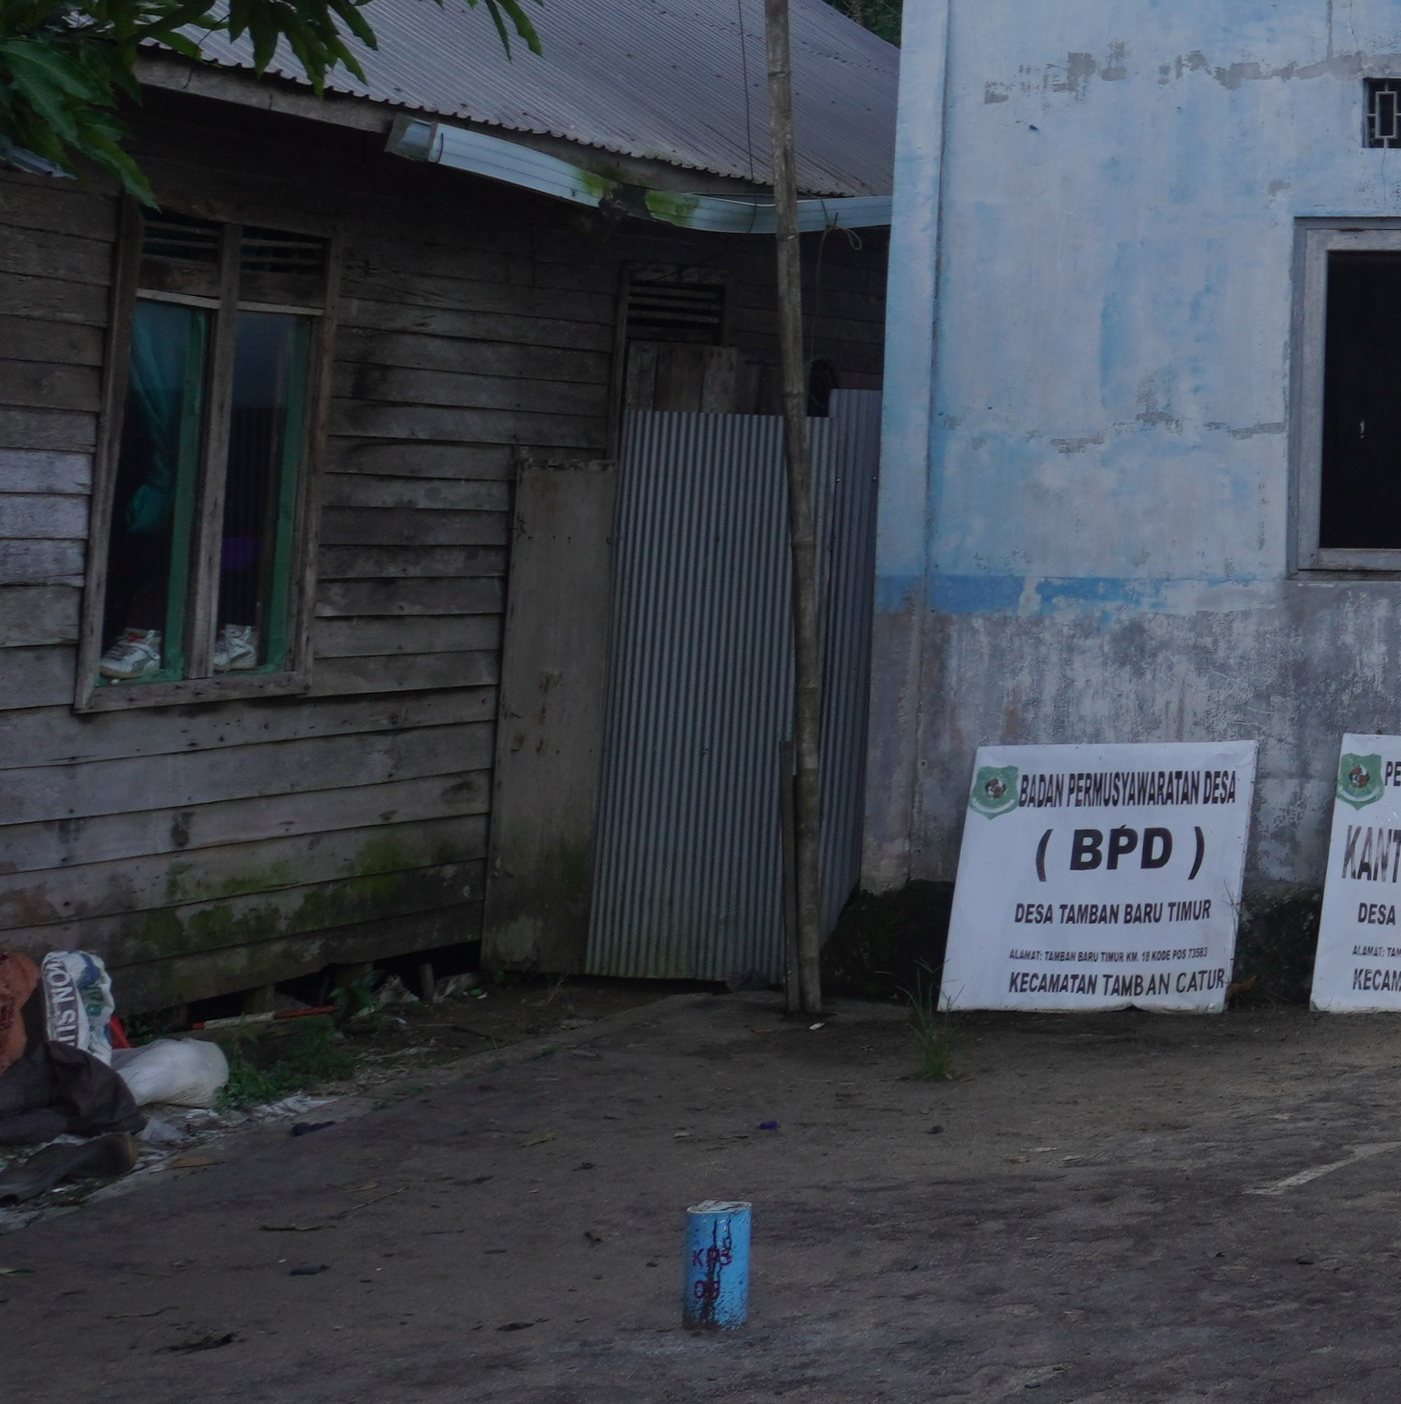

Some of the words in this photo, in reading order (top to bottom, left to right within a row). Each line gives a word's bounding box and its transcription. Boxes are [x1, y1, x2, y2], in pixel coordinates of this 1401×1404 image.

[1018, 774, 1064, 808] BADAN
[1066, 771, 1200, 808] PERMUSYAWARATAN
[1202, 770, 1236, 805] DESA
[1069, 827, 1173, 871] BPD
[1014, 903, 1053, 924] DESA
[1059, 903, 1119, 924] TAMBAN
[1123, 902, 1162, 924] BARU
[1167, 899, 1212, 922] TIMUR
[1357, 902, 1396, 926] DESA
[1009, 948, 1042, 961] ALAMAT:
[1044, 950, 1076, 962] TAMBAN
[1077, 950, 1099, 962] BARU
[1100, 950, 1125, 963] TIMUR
[1126, 951, 1139, 963] KM.
[1151, 949, 1171, 961] KODE
[1172, 948, 1186, 960] POS
[1352, 945, 1385, 958] ALAMAT:
[1009, 971, 1098, 995] KECAMATAN
[1102, 972, 1170, 997] TAMBAN
[1175, 967, 1225, 993] CATUR
